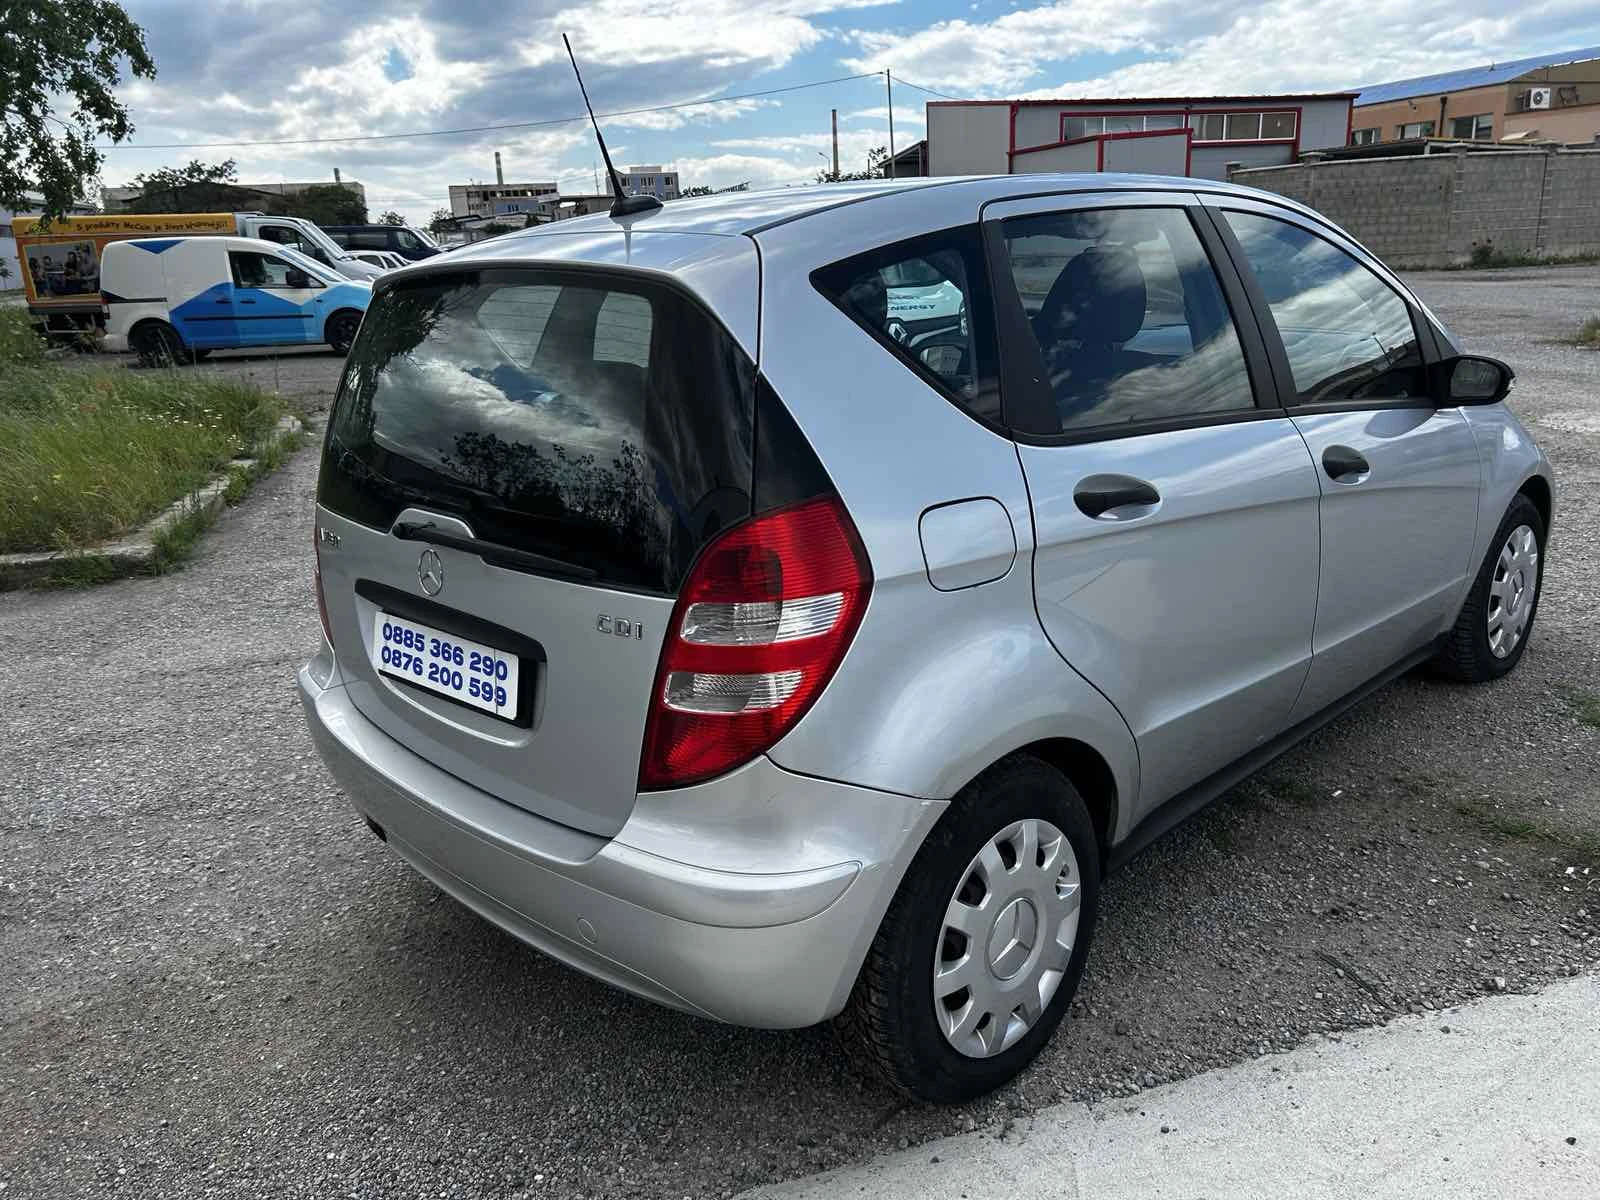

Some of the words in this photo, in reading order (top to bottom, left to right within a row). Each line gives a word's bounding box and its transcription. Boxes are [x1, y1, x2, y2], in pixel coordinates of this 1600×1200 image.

[382, 622, 425, 652] 0885
[430, 638, 465, 666] 366
[469, 652, 508, 681] 290
[597, 614, 642, 640] CDI
[381, 646, 423, 676] 0876
[428, 662, 463, 691] 200
[469, 677, 507, 707] 599
